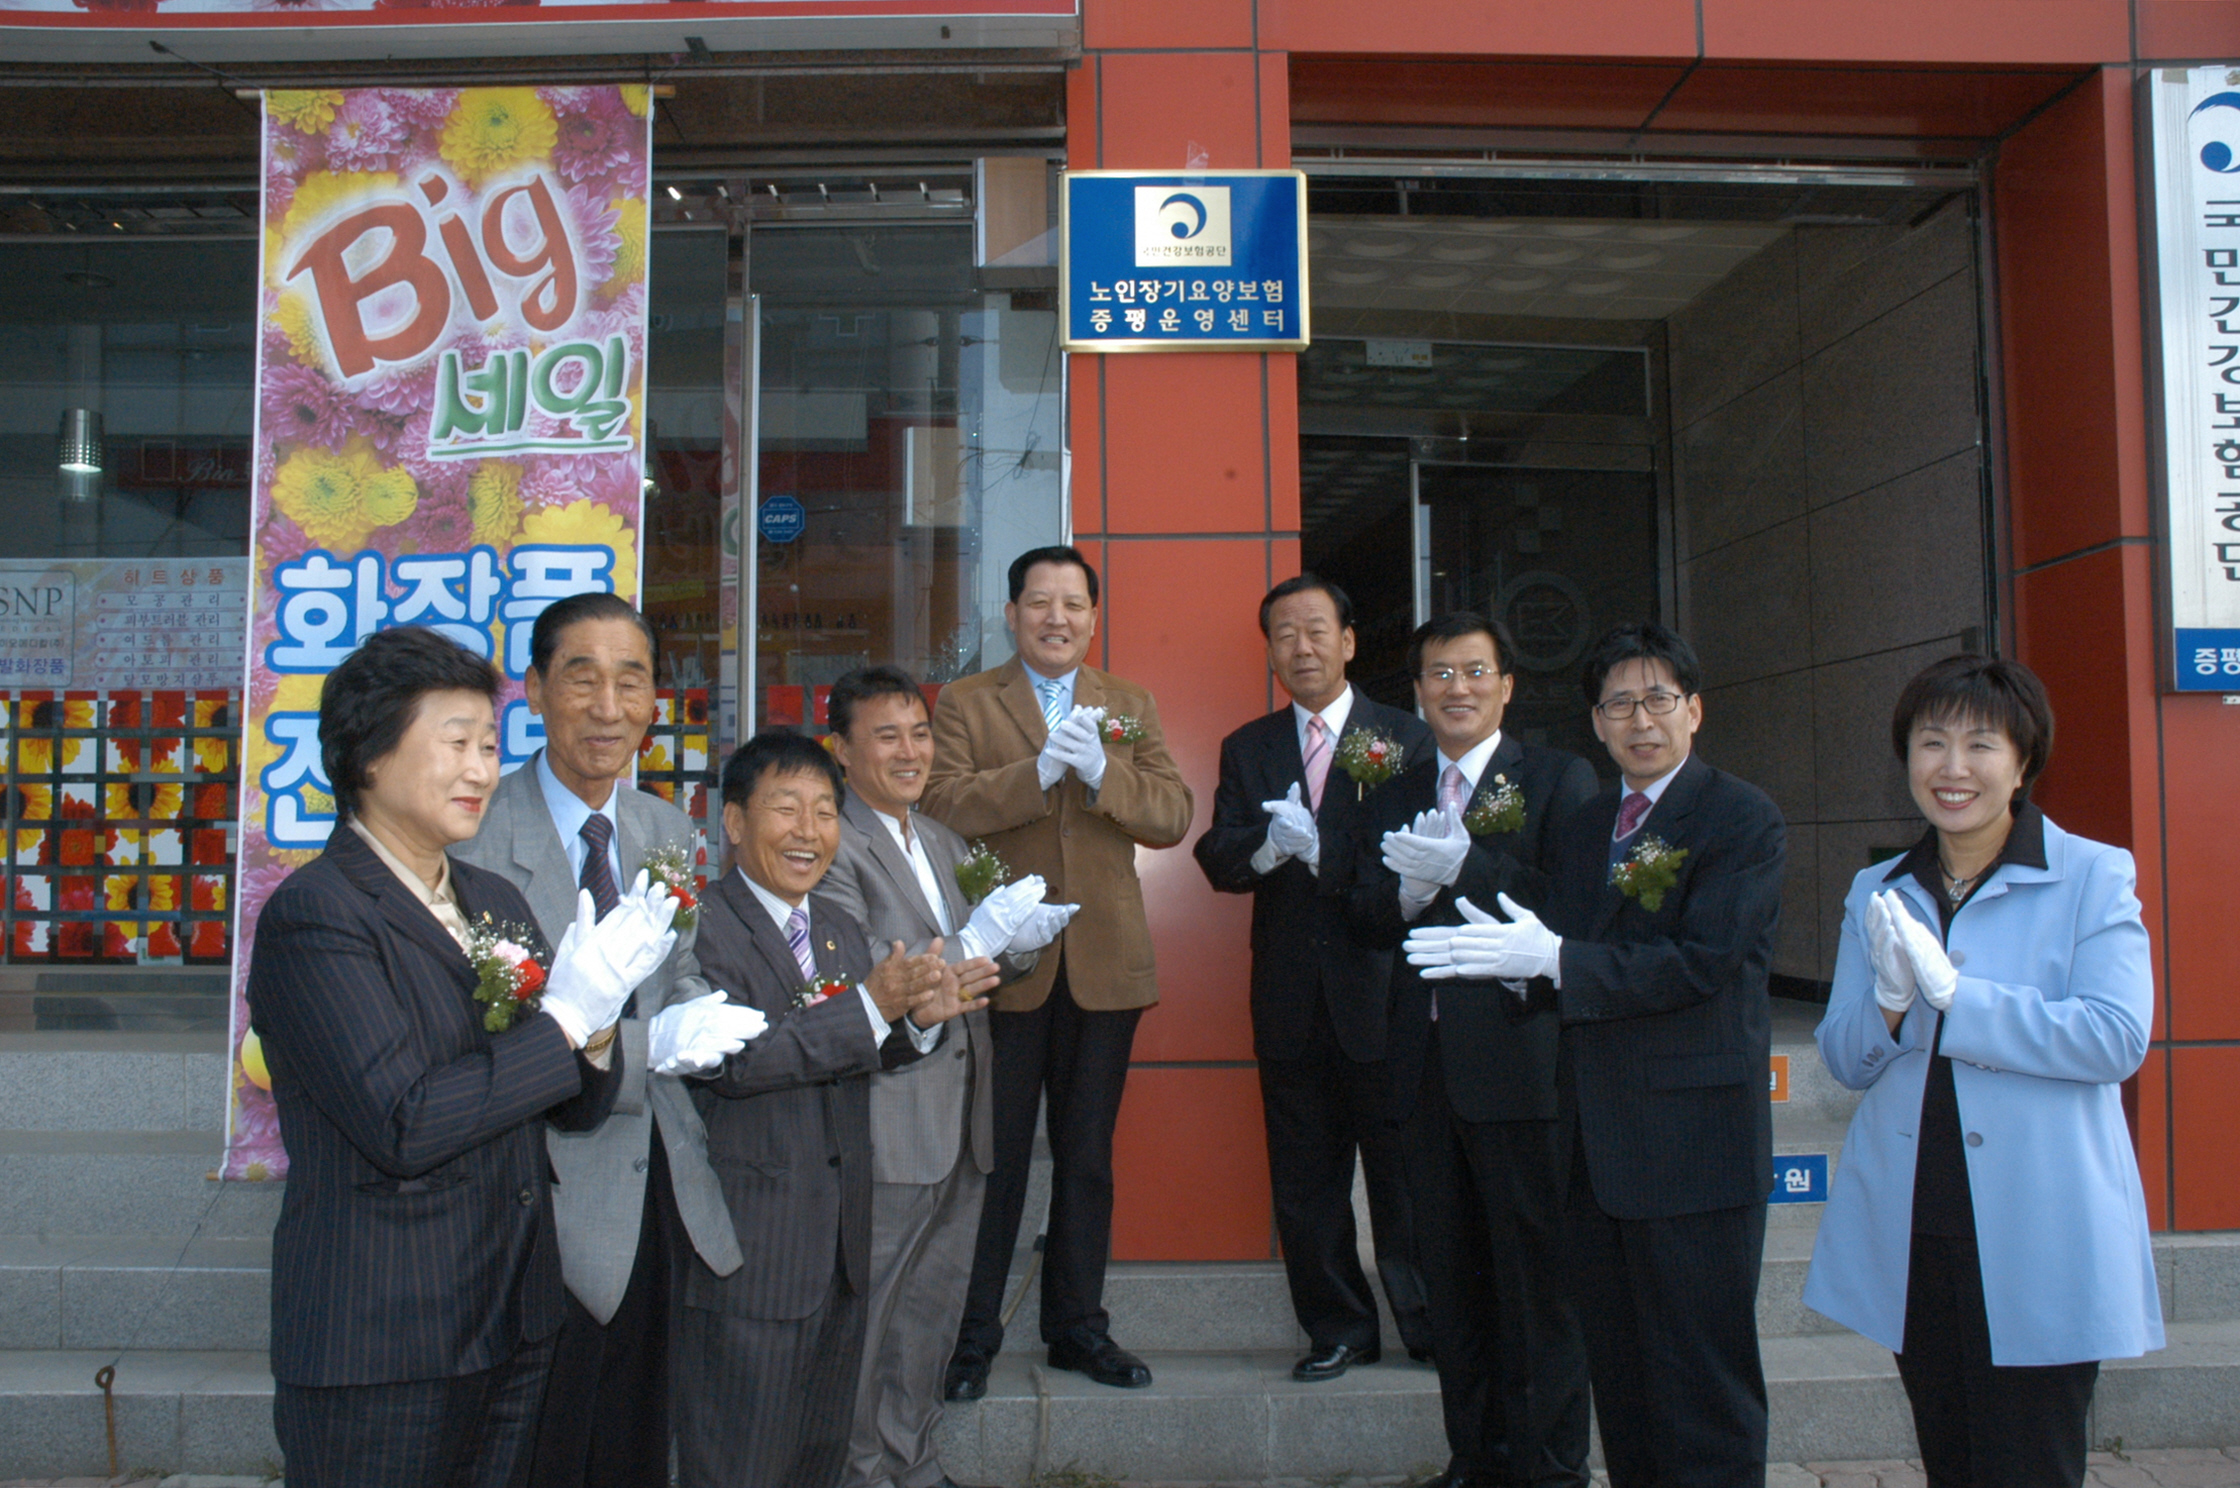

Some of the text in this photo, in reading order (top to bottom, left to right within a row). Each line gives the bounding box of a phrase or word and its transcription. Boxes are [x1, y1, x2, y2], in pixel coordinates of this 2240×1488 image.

[286, 172, 578, 378] Big
[1090, 279, 1284, 303] 노인장기요양보험
[433, 335, 627, 442] 세일
[765, 513, 797, 524] CAPS
[124, 568, 225, 586] 히트상품
